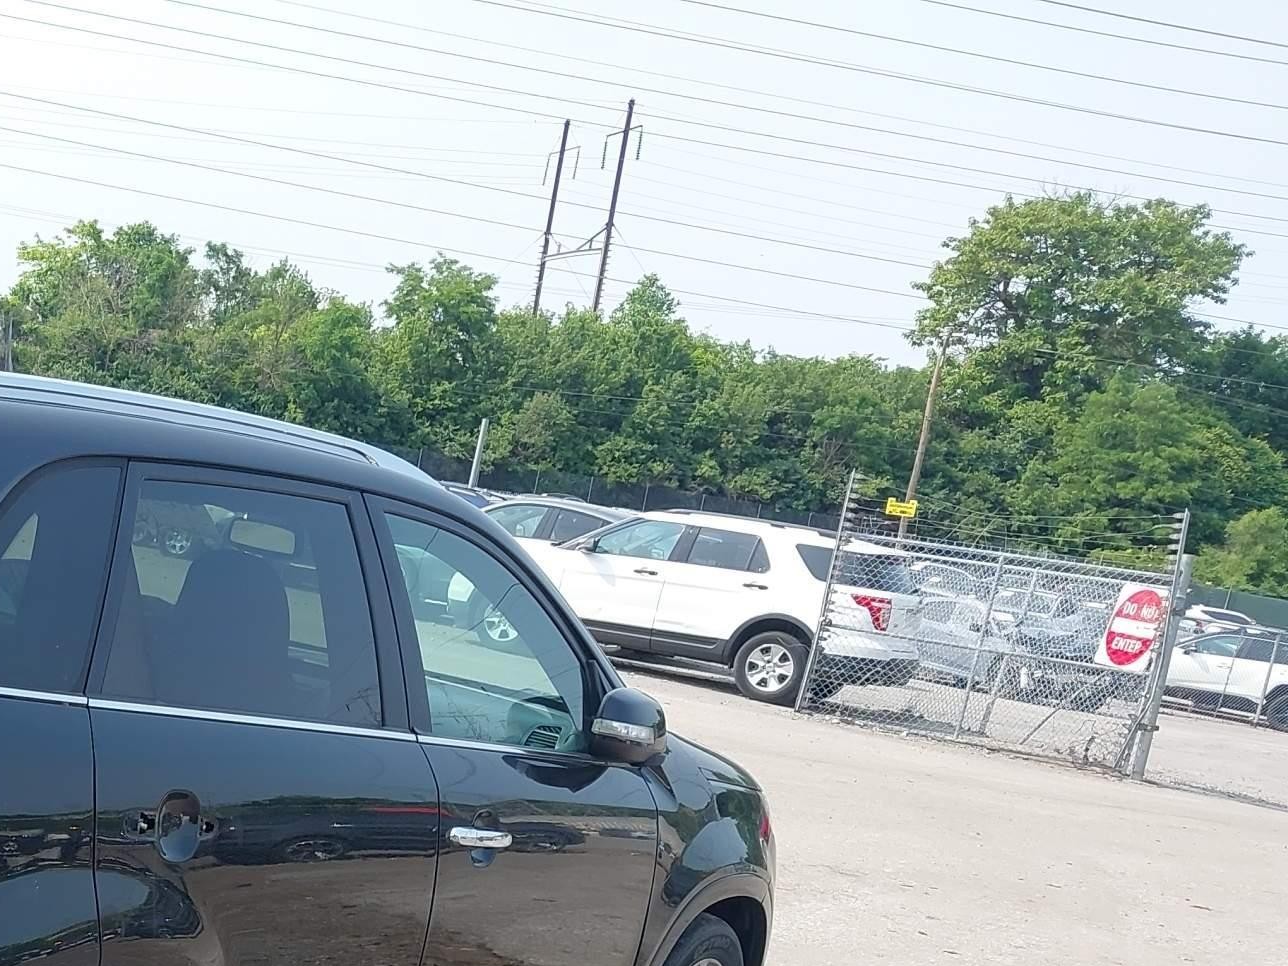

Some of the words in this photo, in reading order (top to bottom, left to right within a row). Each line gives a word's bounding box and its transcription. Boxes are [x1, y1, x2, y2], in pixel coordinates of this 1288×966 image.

[1123, 600, 1138, 616] DO
[1141, 603, 1159, 621] NOT
[1112, 636, 1143, 654] ENTER
